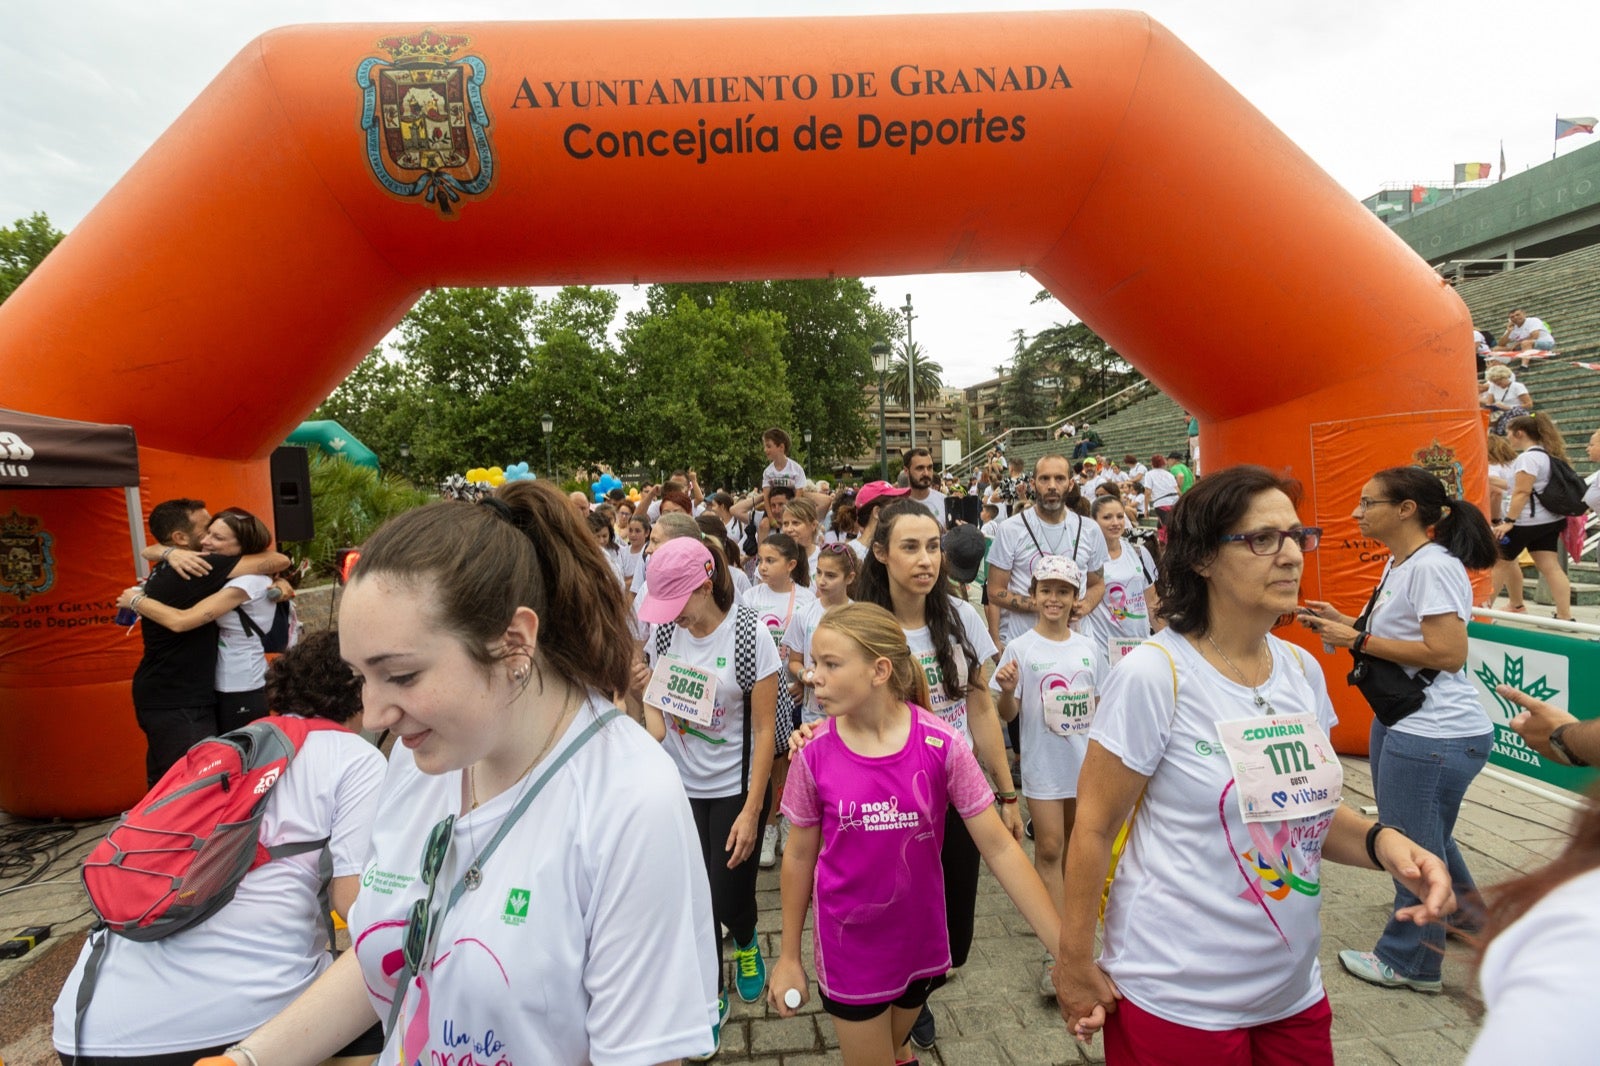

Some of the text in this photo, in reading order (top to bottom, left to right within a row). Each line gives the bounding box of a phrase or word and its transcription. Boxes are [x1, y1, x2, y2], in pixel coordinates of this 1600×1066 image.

[510, 64, 1073, 110] AYUNTAMIENTO DE GRANADA
[563, 108, 1026, 164] Concejalía de Deportes
[24, 618, 42, 629] de
[669, 664, 709, 682] COVIRAN
[667, 674, 704, 700] 3845
[672, 701, 699, 716] vithas
[1062, 701, 1088, 718] 4715
[1241, 723, 1304, 741] COVIRAN
[1262, 740, 1316, 775] 1772
[1290, 776, 1309, 786] GUSTI
[1291, 787, 1329, 805] vithas
[861, 801, 890, 813] nos
[862, 811, 918, 824] sobran
[864, 820, 919, 832] losmotivos
[443, 1019, 470, 1048] Un
